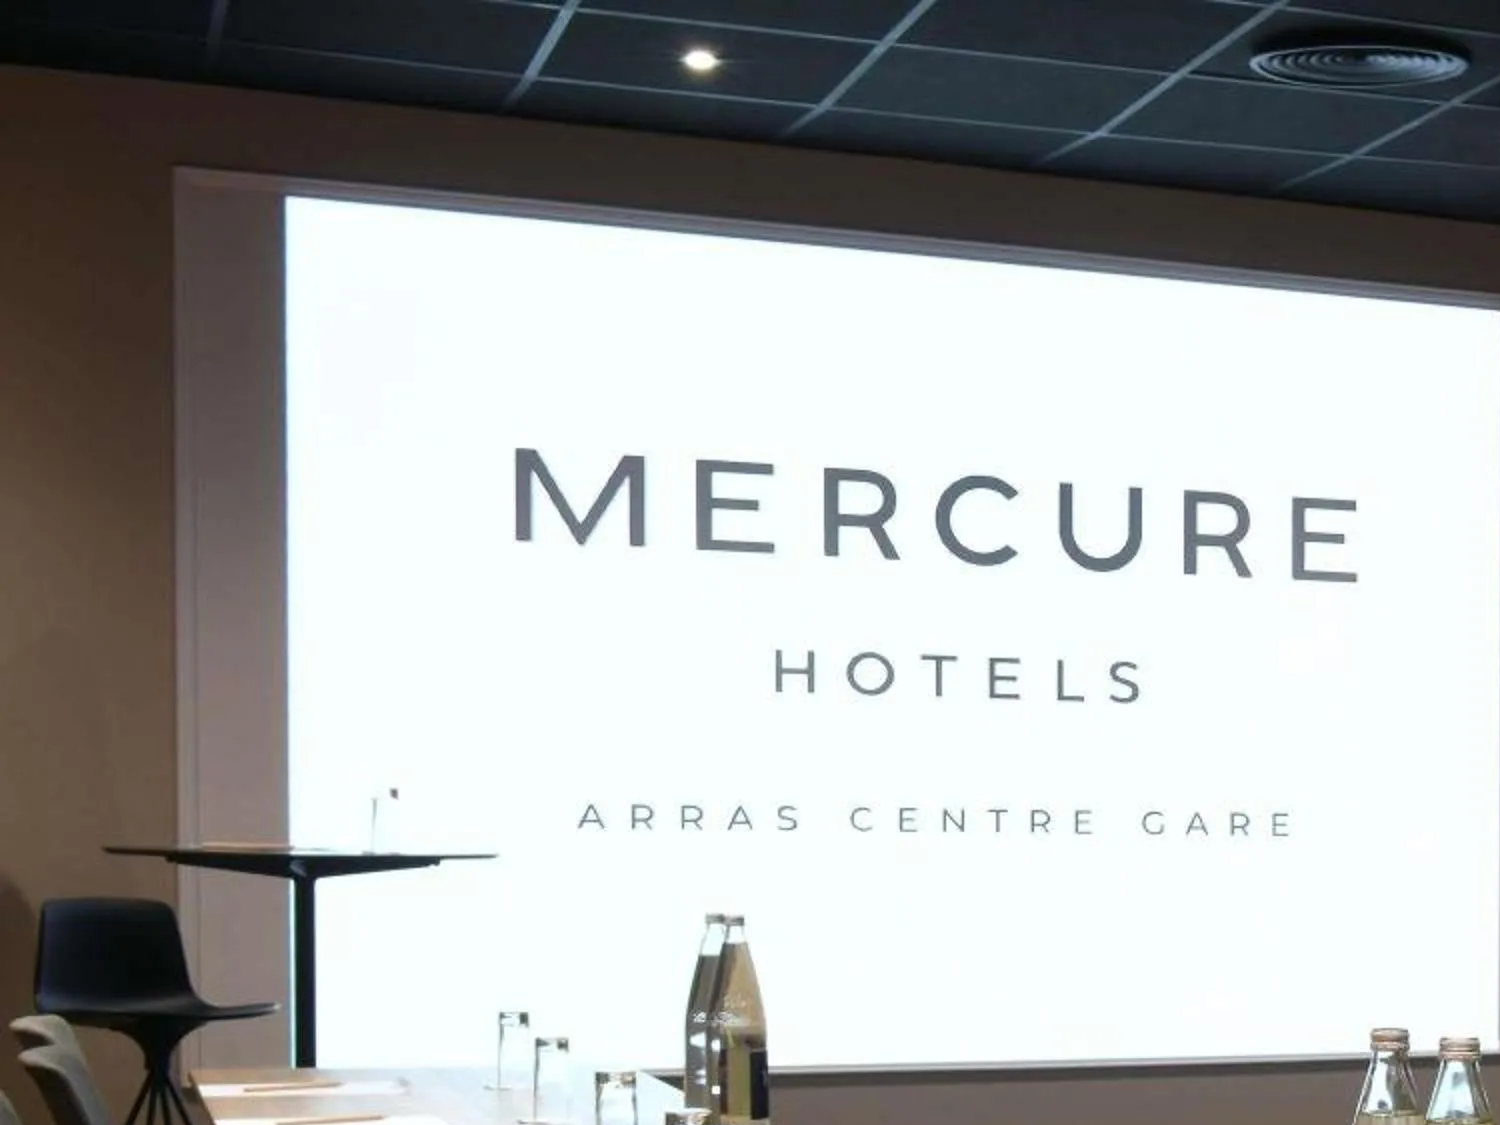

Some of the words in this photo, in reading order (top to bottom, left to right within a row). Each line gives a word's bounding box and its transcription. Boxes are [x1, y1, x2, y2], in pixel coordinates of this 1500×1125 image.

[514, 447, 1358, 583] MERCURE
[774, 648, 1140, 705] HOTELS
[577, 803, 799, 832] ARRAS
[850, 806, 1094, 836] CENTRE
[1141, 810, 1290, 838] GARE
